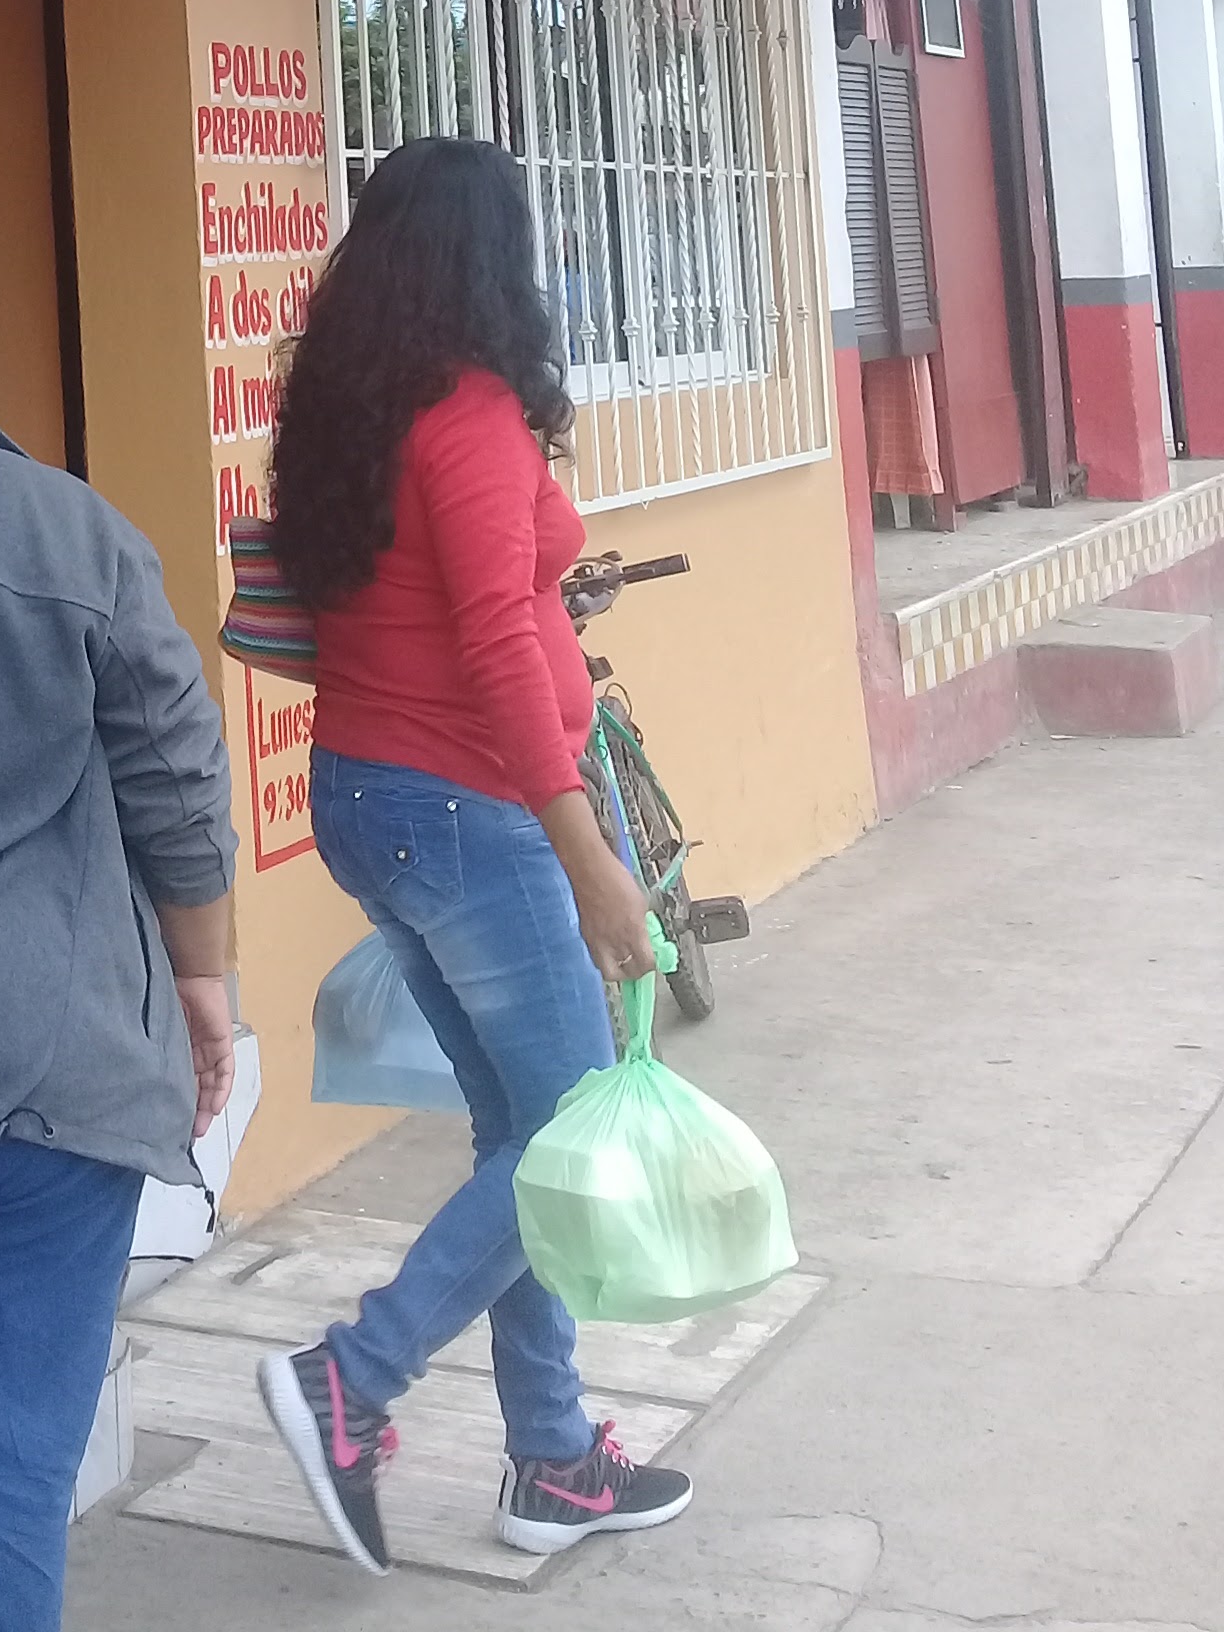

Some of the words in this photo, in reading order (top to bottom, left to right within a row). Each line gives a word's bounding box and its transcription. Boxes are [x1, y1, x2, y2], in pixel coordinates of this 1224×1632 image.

[210, 42, 307, 102] POLLOS
[197, 106, 325, 159] PREPARADOS
[202, 181, 328, 256] Enchilados
[207, 274, 227, 343] A
[232, 269, 272, 340] dos
[213, 365, 237, 436] Al
[257, 697, 312, 759] Lunes
